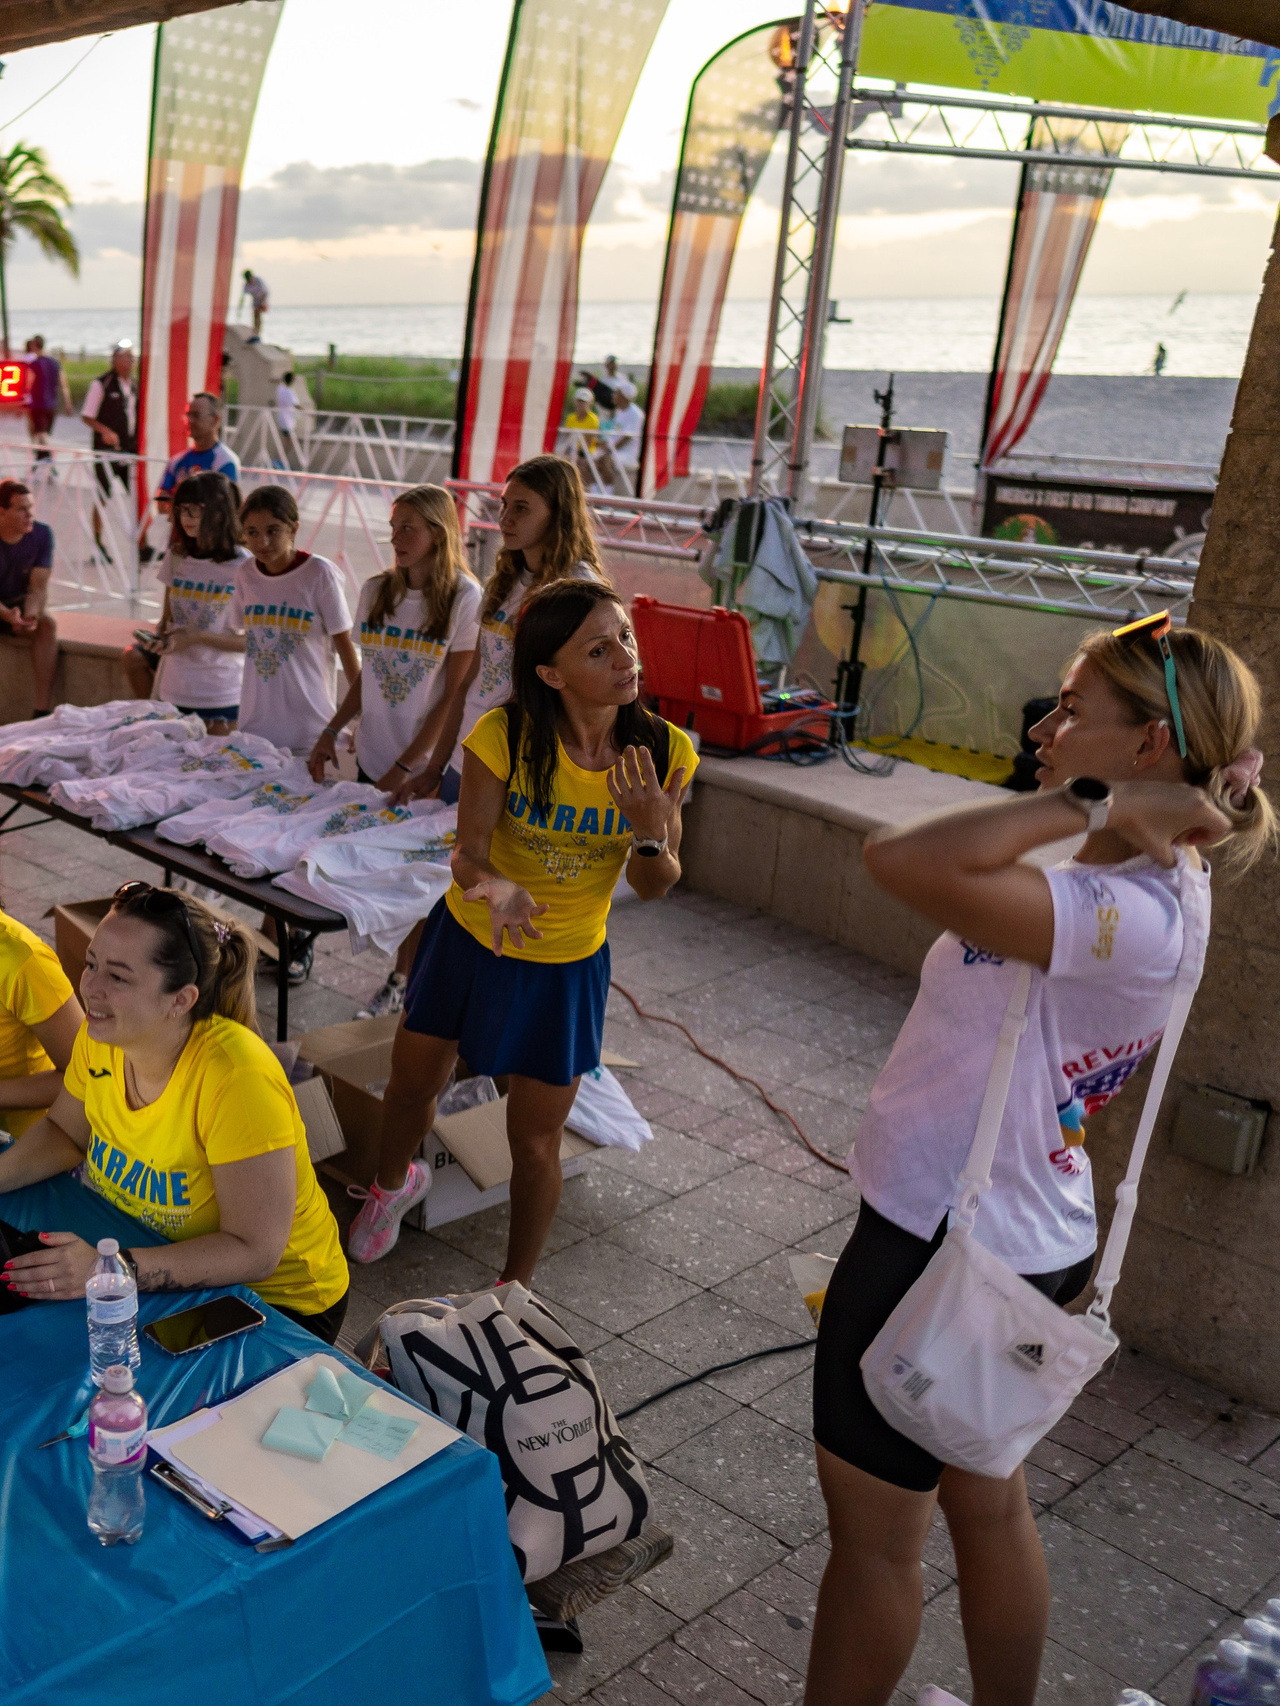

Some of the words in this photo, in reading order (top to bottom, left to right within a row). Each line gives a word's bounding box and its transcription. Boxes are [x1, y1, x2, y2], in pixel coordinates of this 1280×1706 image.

[508, 791, 634, 836] UKRAIN
[89, 1133, 191, 1207] KRAINE
[517, 1432, 550, 1453] NEW
[551, 1416, 595, 1445] YORKER
[551, 1418, 568, 1429] THE
